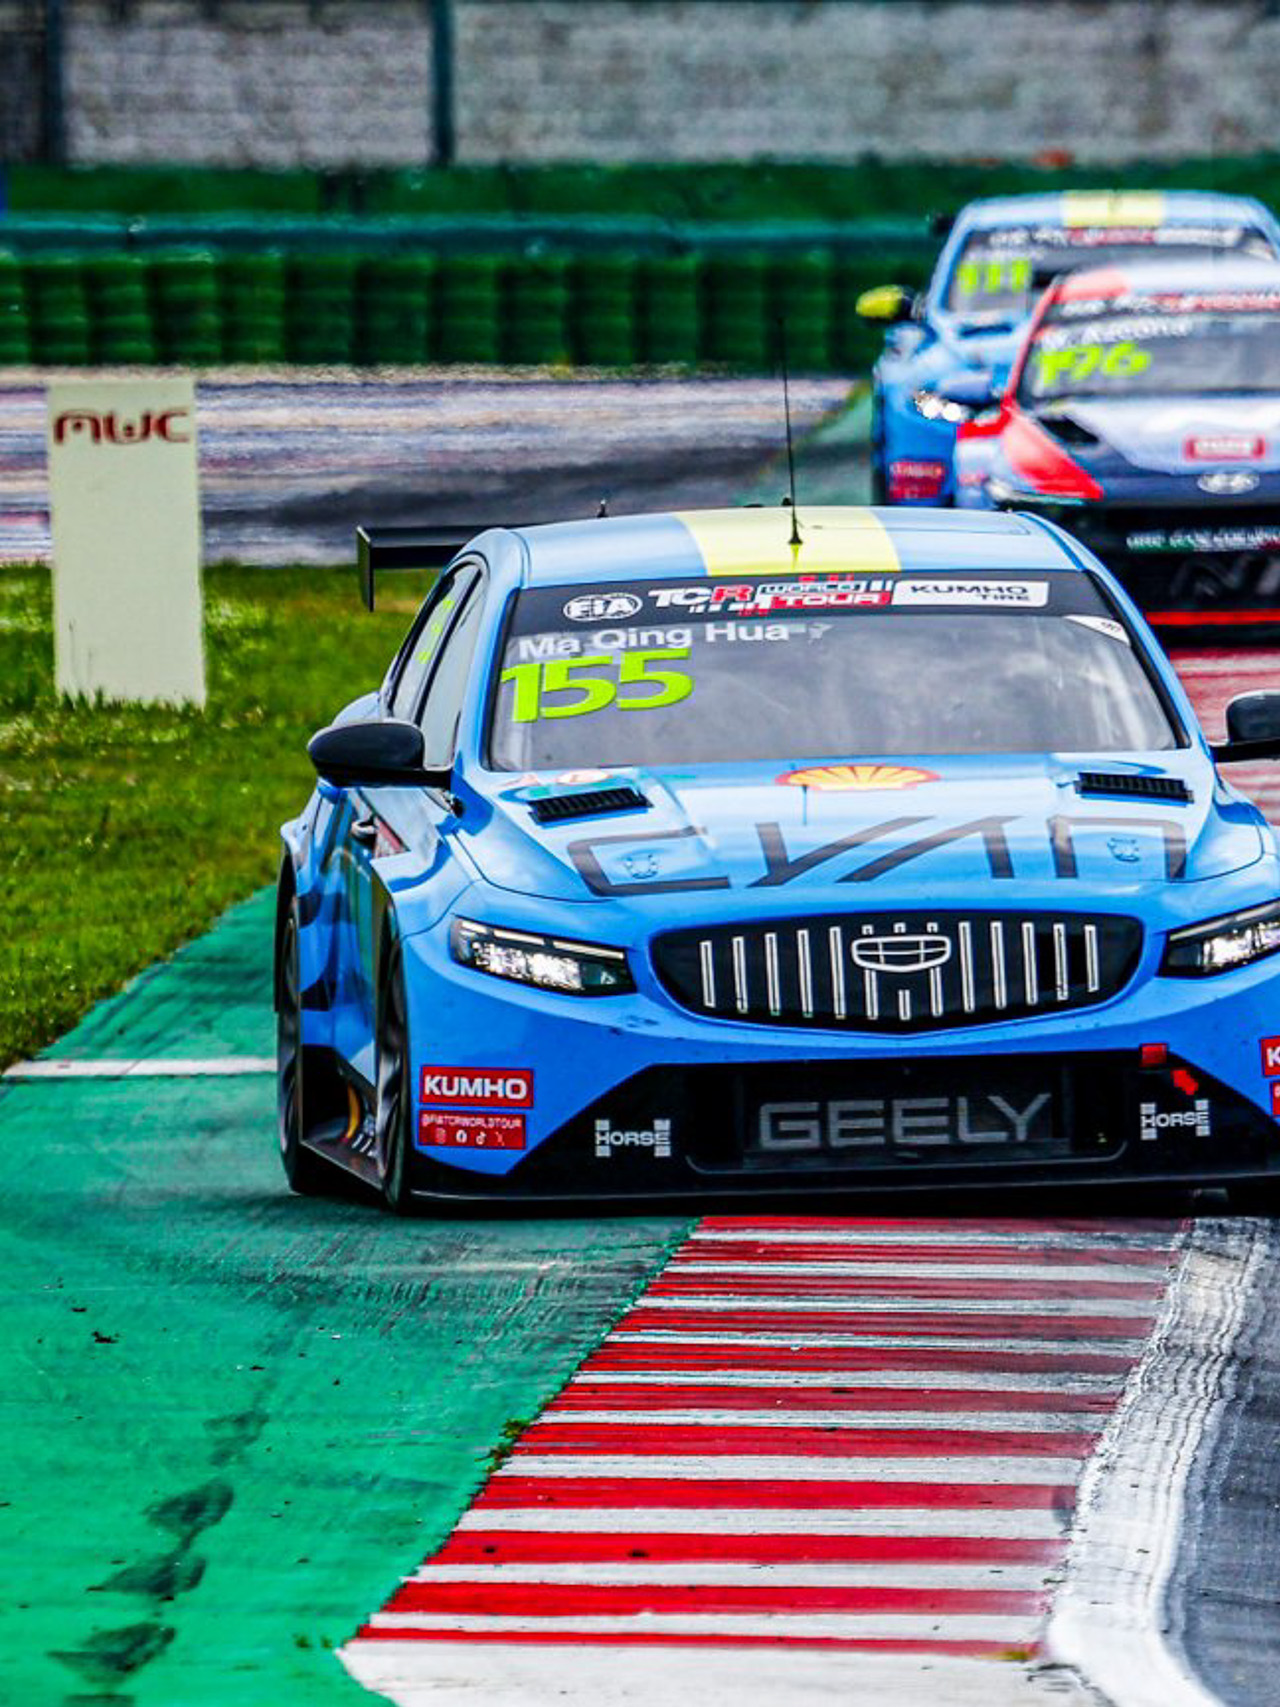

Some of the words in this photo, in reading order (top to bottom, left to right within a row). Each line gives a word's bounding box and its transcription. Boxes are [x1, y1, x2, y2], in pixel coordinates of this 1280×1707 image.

[568, 597, 635, 618] FIA
[648, 584, 753, 607] TCR
[780, 594, 880, 606] TOUR
[910, 584, 1031, 595] KUMHO
[519, 637, 582, 659] Ma
[592, 627, 693, 649] Qing
[706, 622, 790, 643] Hua
[500, 648, 694, 724] 155
[423, 1074, 528, 1100] KUMHO
[759, 1092, 1052, 1149] GEELY
